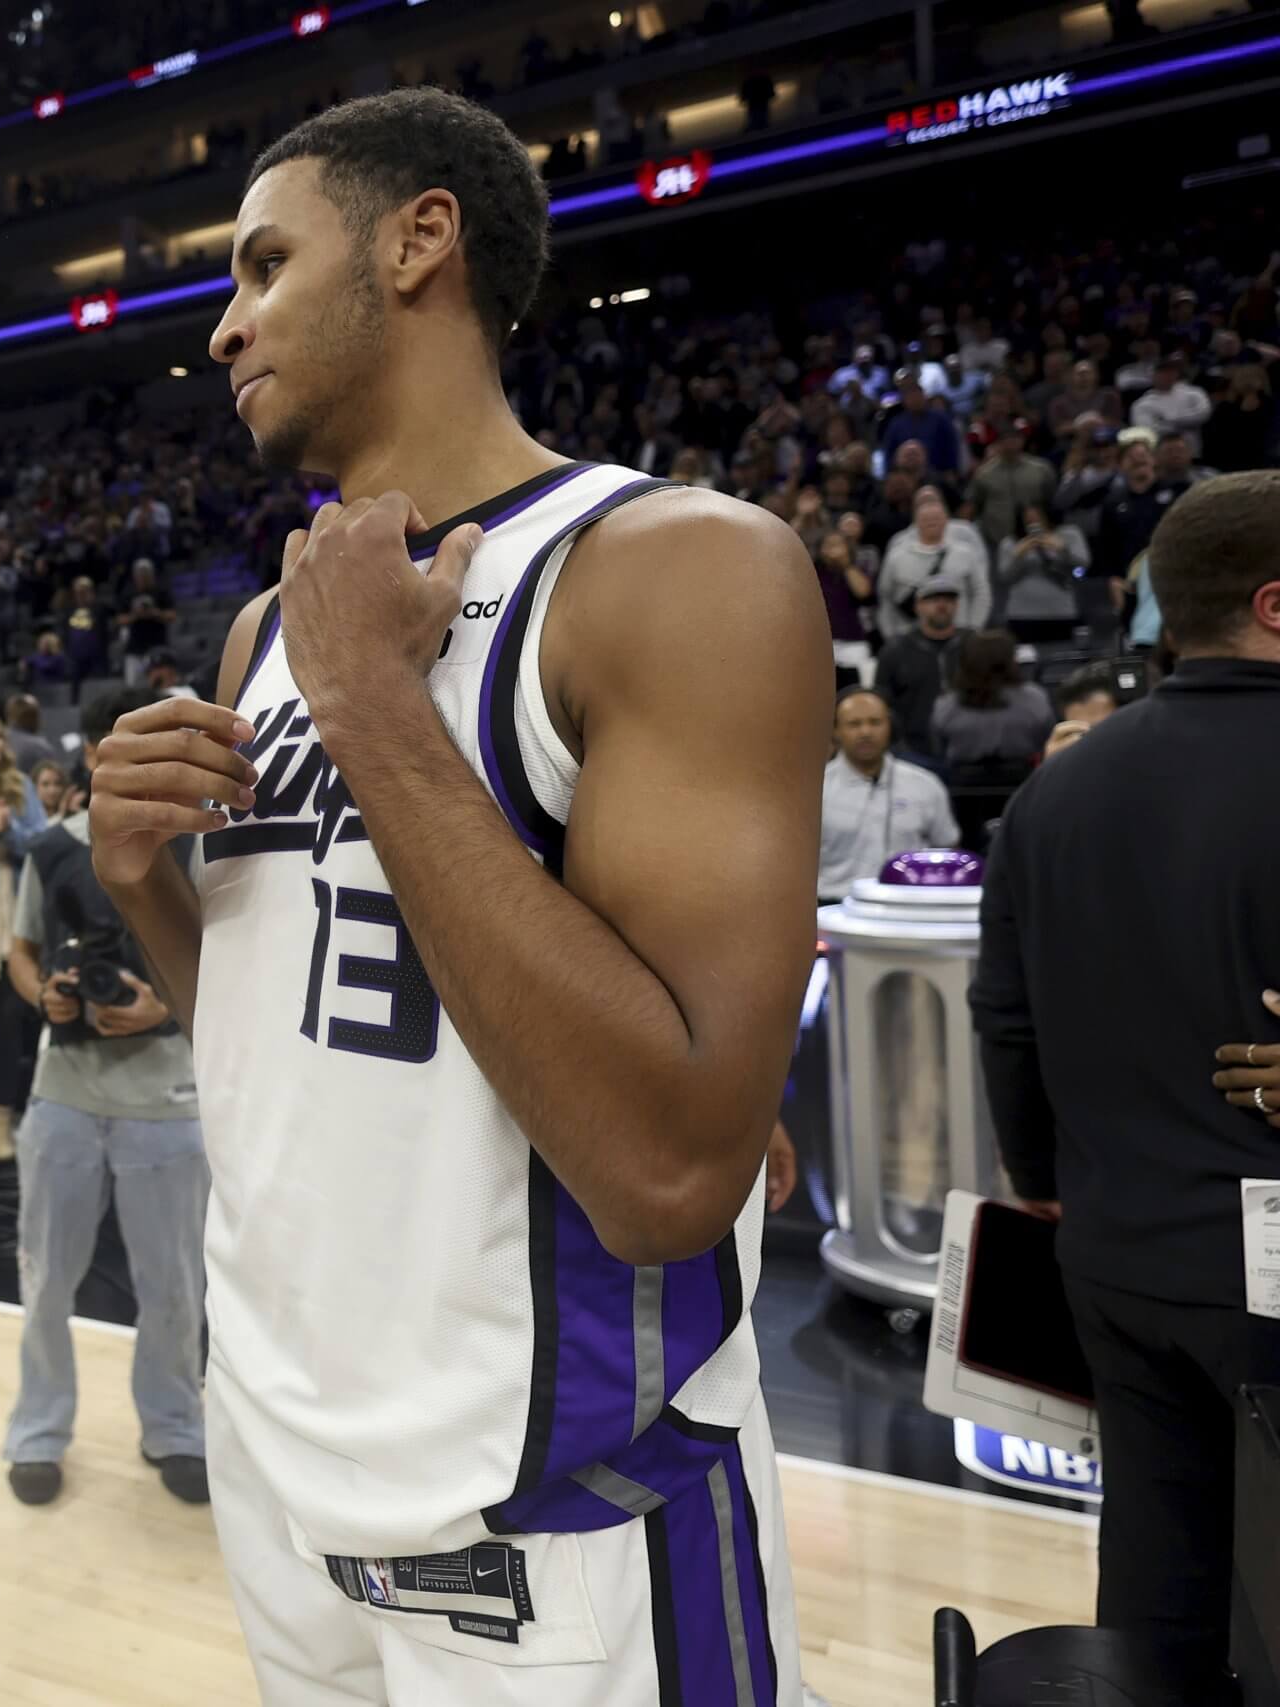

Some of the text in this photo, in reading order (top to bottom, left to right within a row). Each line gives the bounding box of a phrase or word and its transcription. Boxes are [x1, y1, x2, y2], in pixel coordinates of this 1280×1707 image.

[886, 72, 1070, 134] REDHAWK
[300, 877, 440, 1063] 13
[398, 1559, 413, 1573] 50
